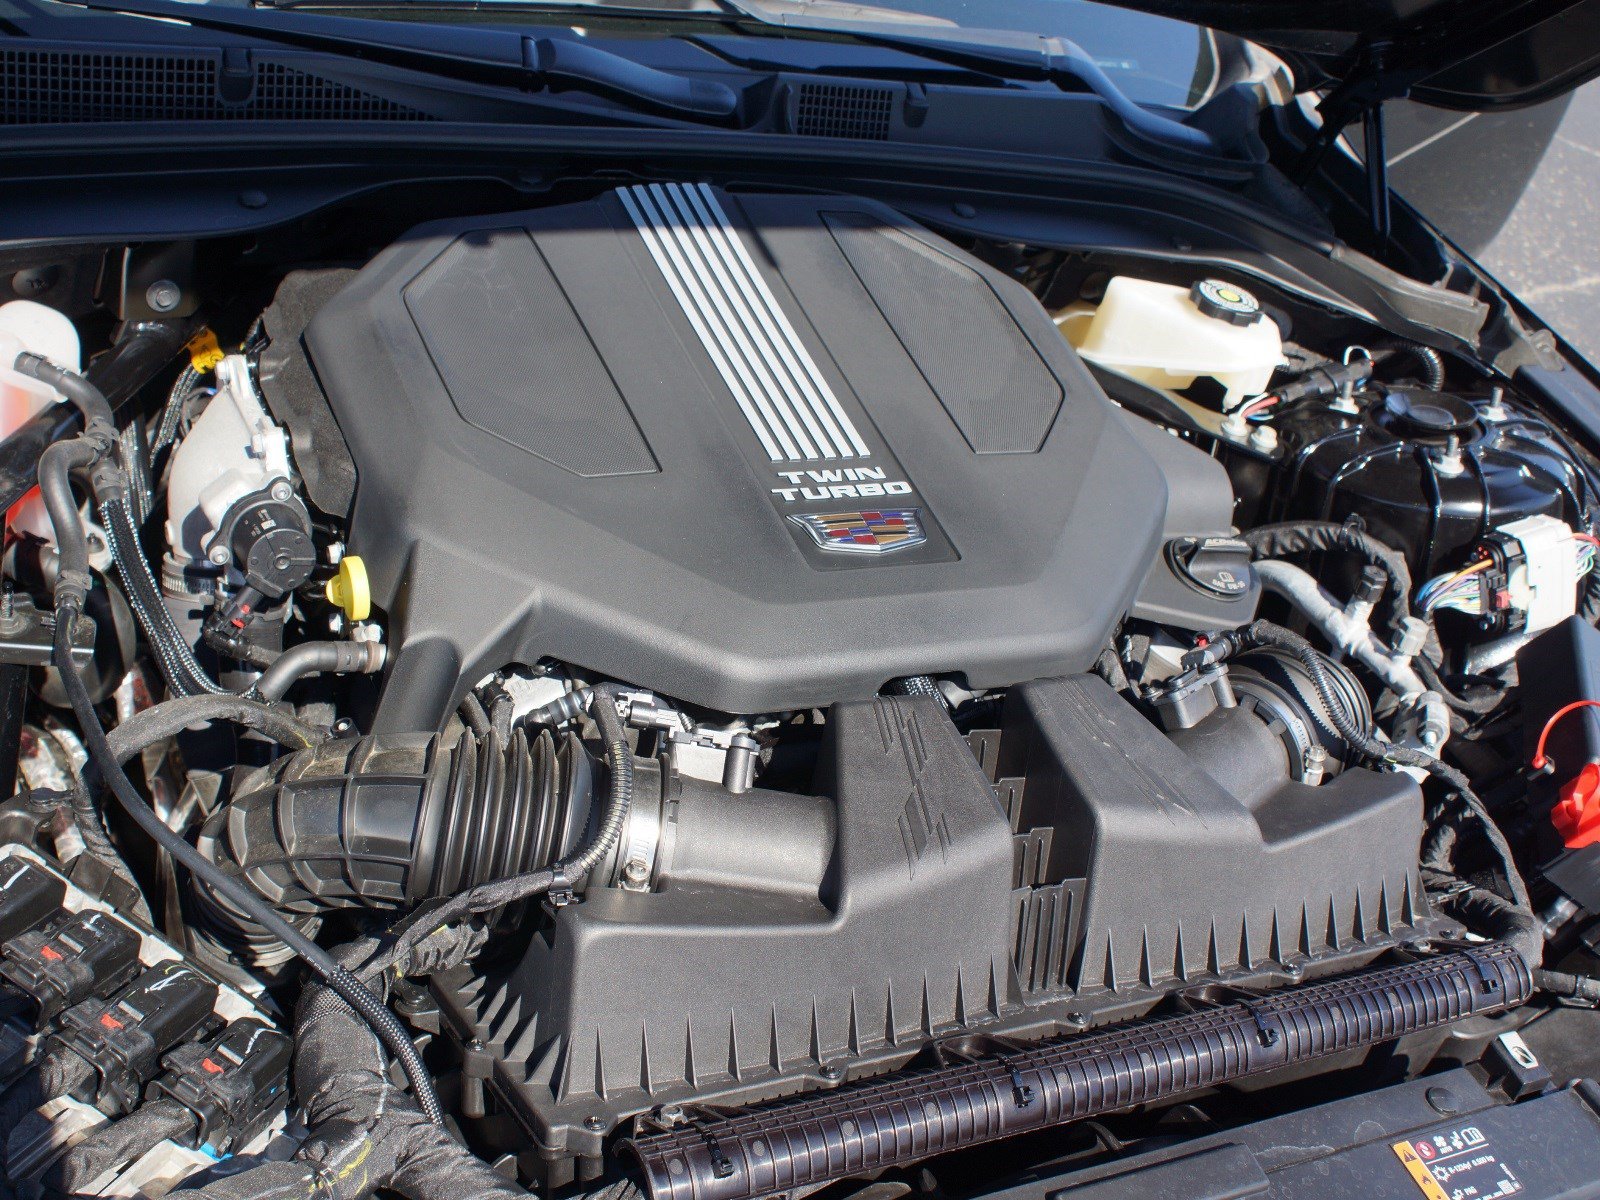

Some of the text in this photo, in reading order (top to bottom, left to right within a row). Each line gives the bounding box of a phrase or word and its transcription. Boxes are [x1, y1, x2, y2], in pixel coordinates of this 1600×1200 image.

[777, 466, 887, 485] TWIN
[771, 481, 913, 501] TURBO
[1464, 1186, 1478, 1196] PAG
